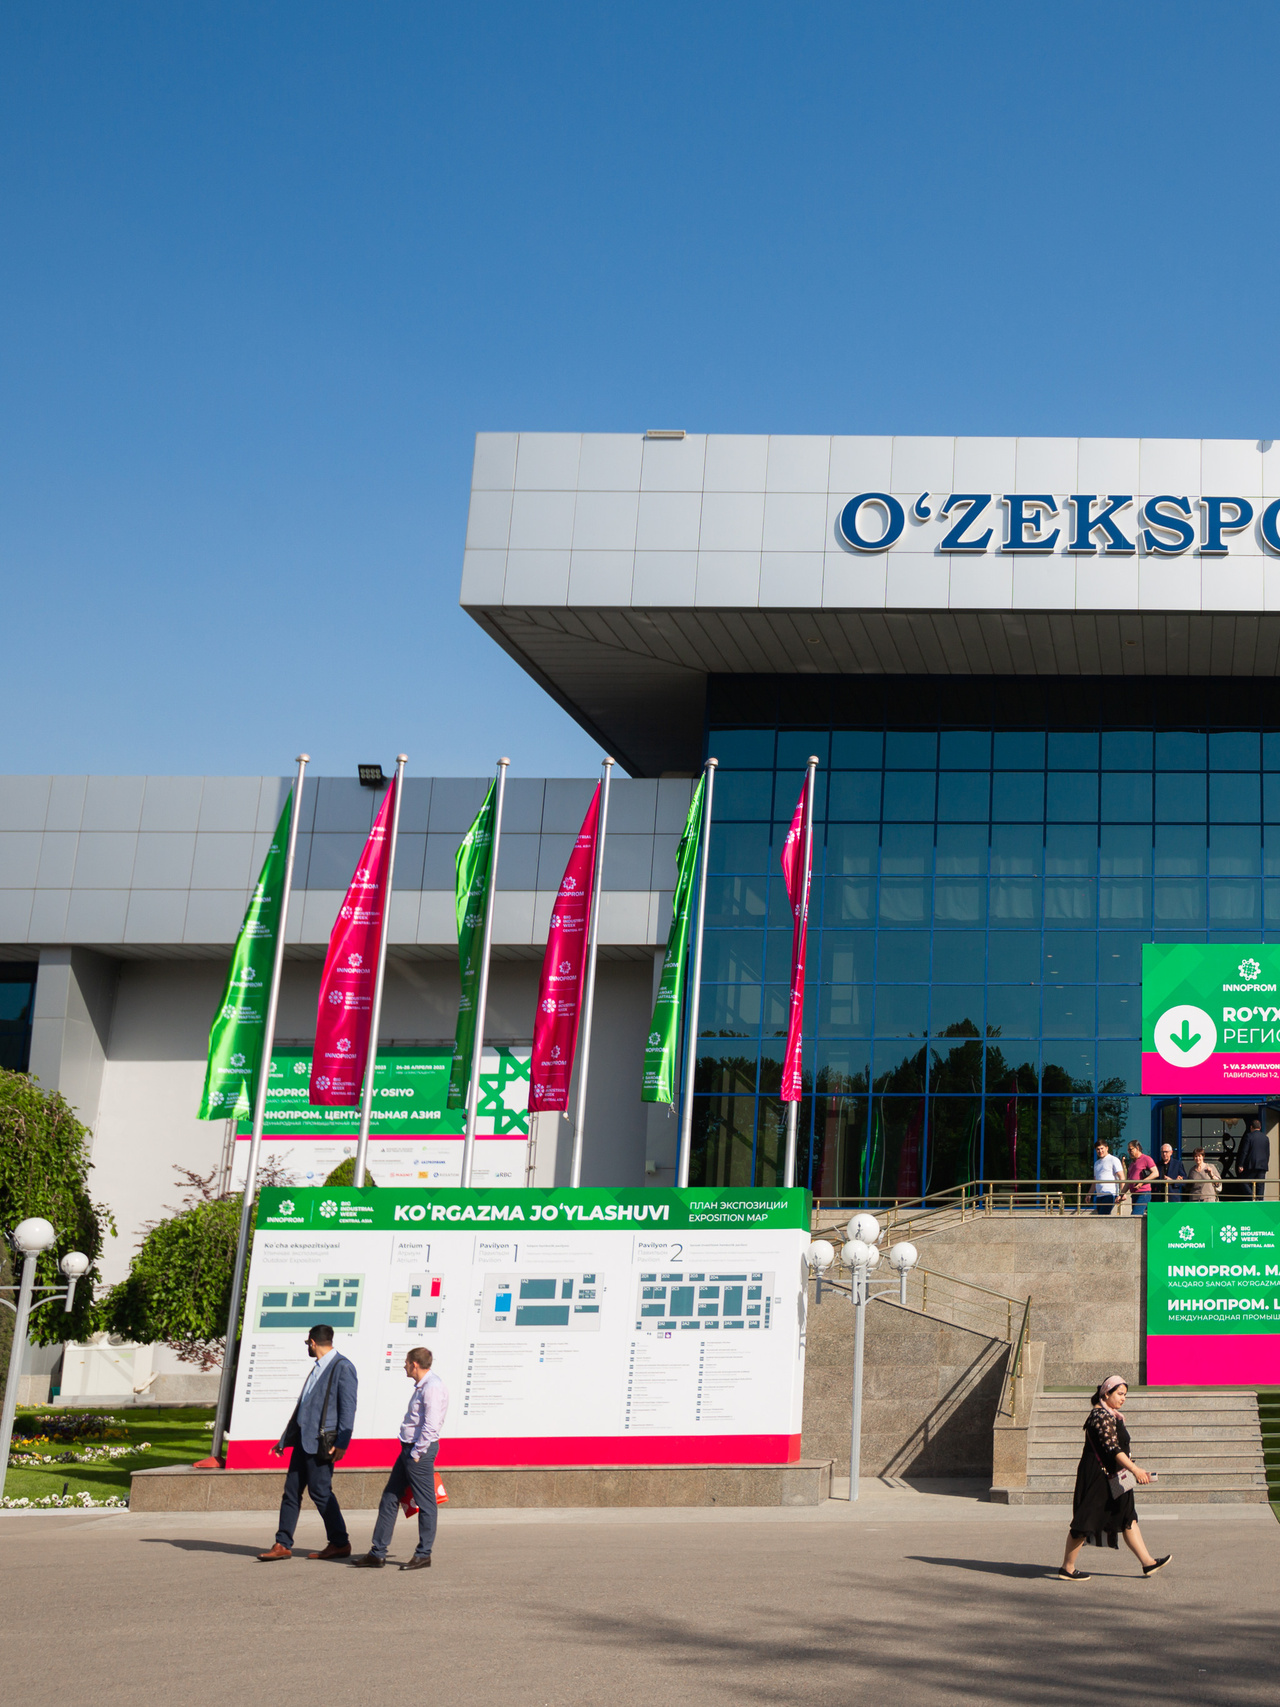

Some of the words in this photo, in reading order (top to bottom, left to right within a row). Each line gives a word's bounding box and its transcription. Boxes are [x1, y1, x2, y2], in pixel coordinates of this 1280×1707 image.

[1223, 984, 1276, 992] INNOPROM
[381, 1088, 414, 1096] OSIYO
[264, 1111, 321, 1120] ННОПРОМ.
[325, 1110, 407, 1121] ЦЕНТЛЬНАЯ
[410, 1111, 441, 1119] АЗИЯ
[690, 1202, 717, 1210] ПЛАН
[720, 1201, 788, 1210] ЭКСПОЗИЦИИ
[689, 1214, 744, 1222] EXPOSITION
[747, 1214, 768, 1222] MAP
[426, 1244, 431, 1262] 1
[514, 1244, 518, 1262] 1
[670, 1243, 683, 1262] 2
[1168, 1265, 1260, 1277] INNOPROM.
[1168, 1299, 1269, 1310] ИННОПРОМ.
